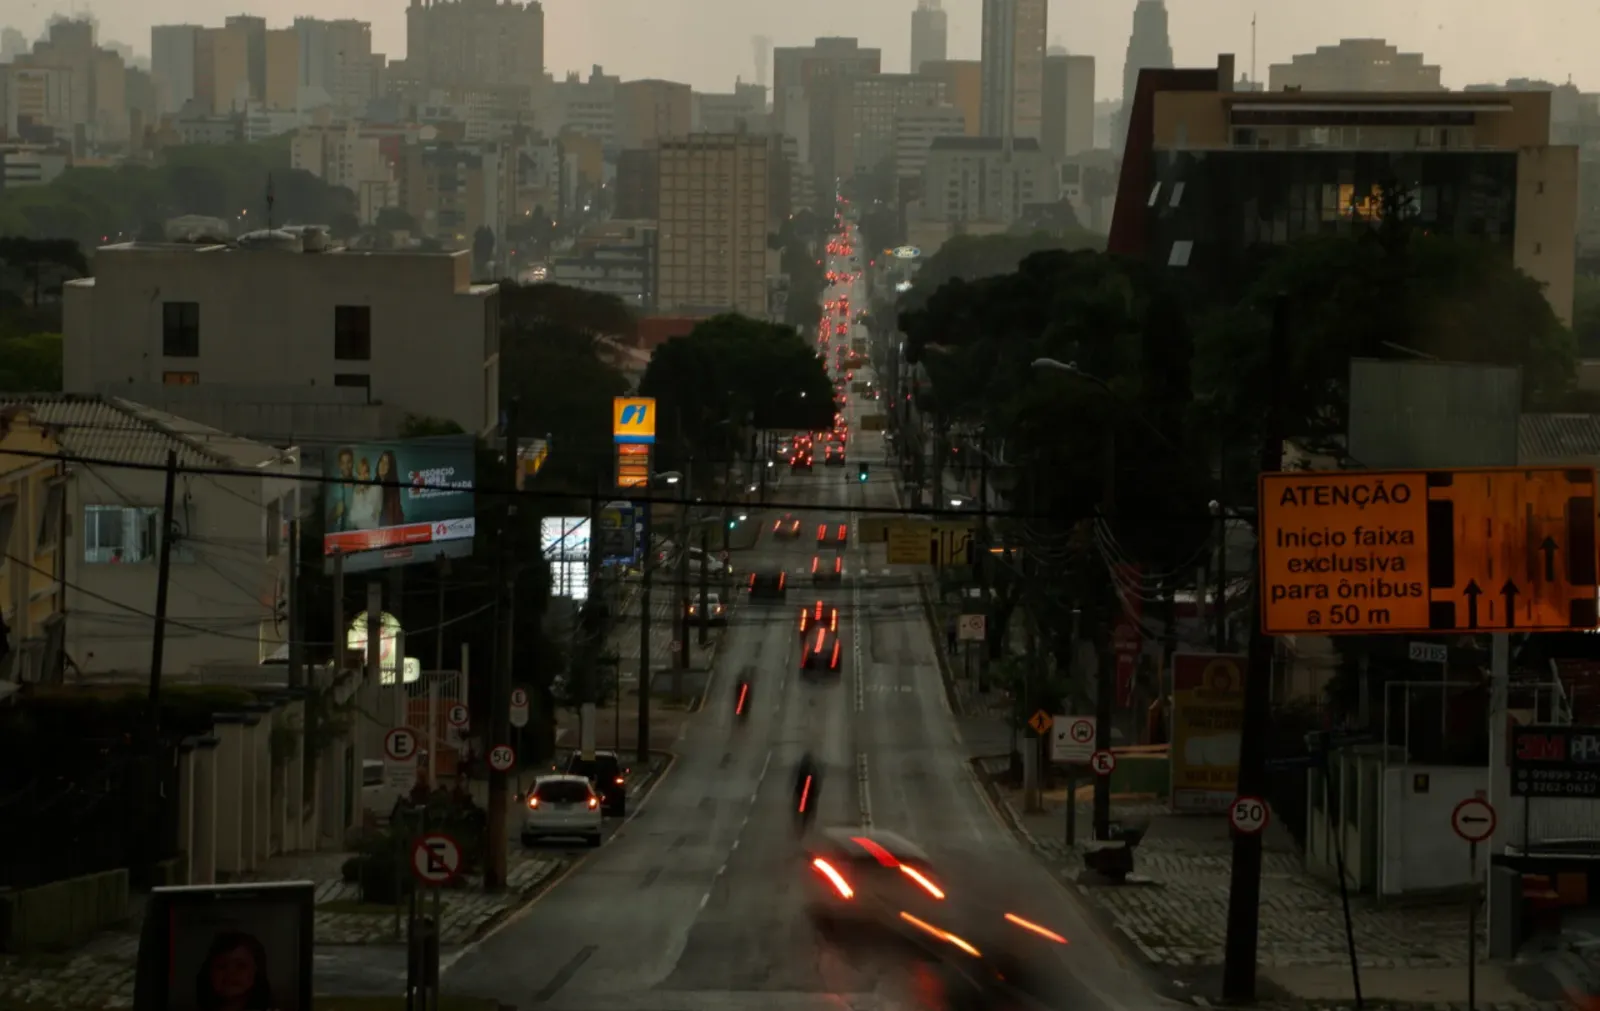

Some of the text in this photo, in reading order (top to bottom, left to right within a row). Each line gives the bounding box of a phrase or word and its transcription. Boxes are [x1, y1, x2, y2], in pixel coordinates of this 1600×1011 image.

[1280, 480, 1411, 509] ATENÇÃO
[1354, 525, 1415, 545] faixa
[1287, 552, 1406, 573] exclusiva
[1271, 578, 1423, 603] para ônibus
[1307, 604, 1390, 626] a 50 m
[454, 708, 464, 721] E
[395, 734, 407, 753] E
[1516, 733, 1566, 760] 3M
[493, 751, 513, 763] 50
[1237, 804, 1262, 821] 50
[428, 843, 447, 872] E
